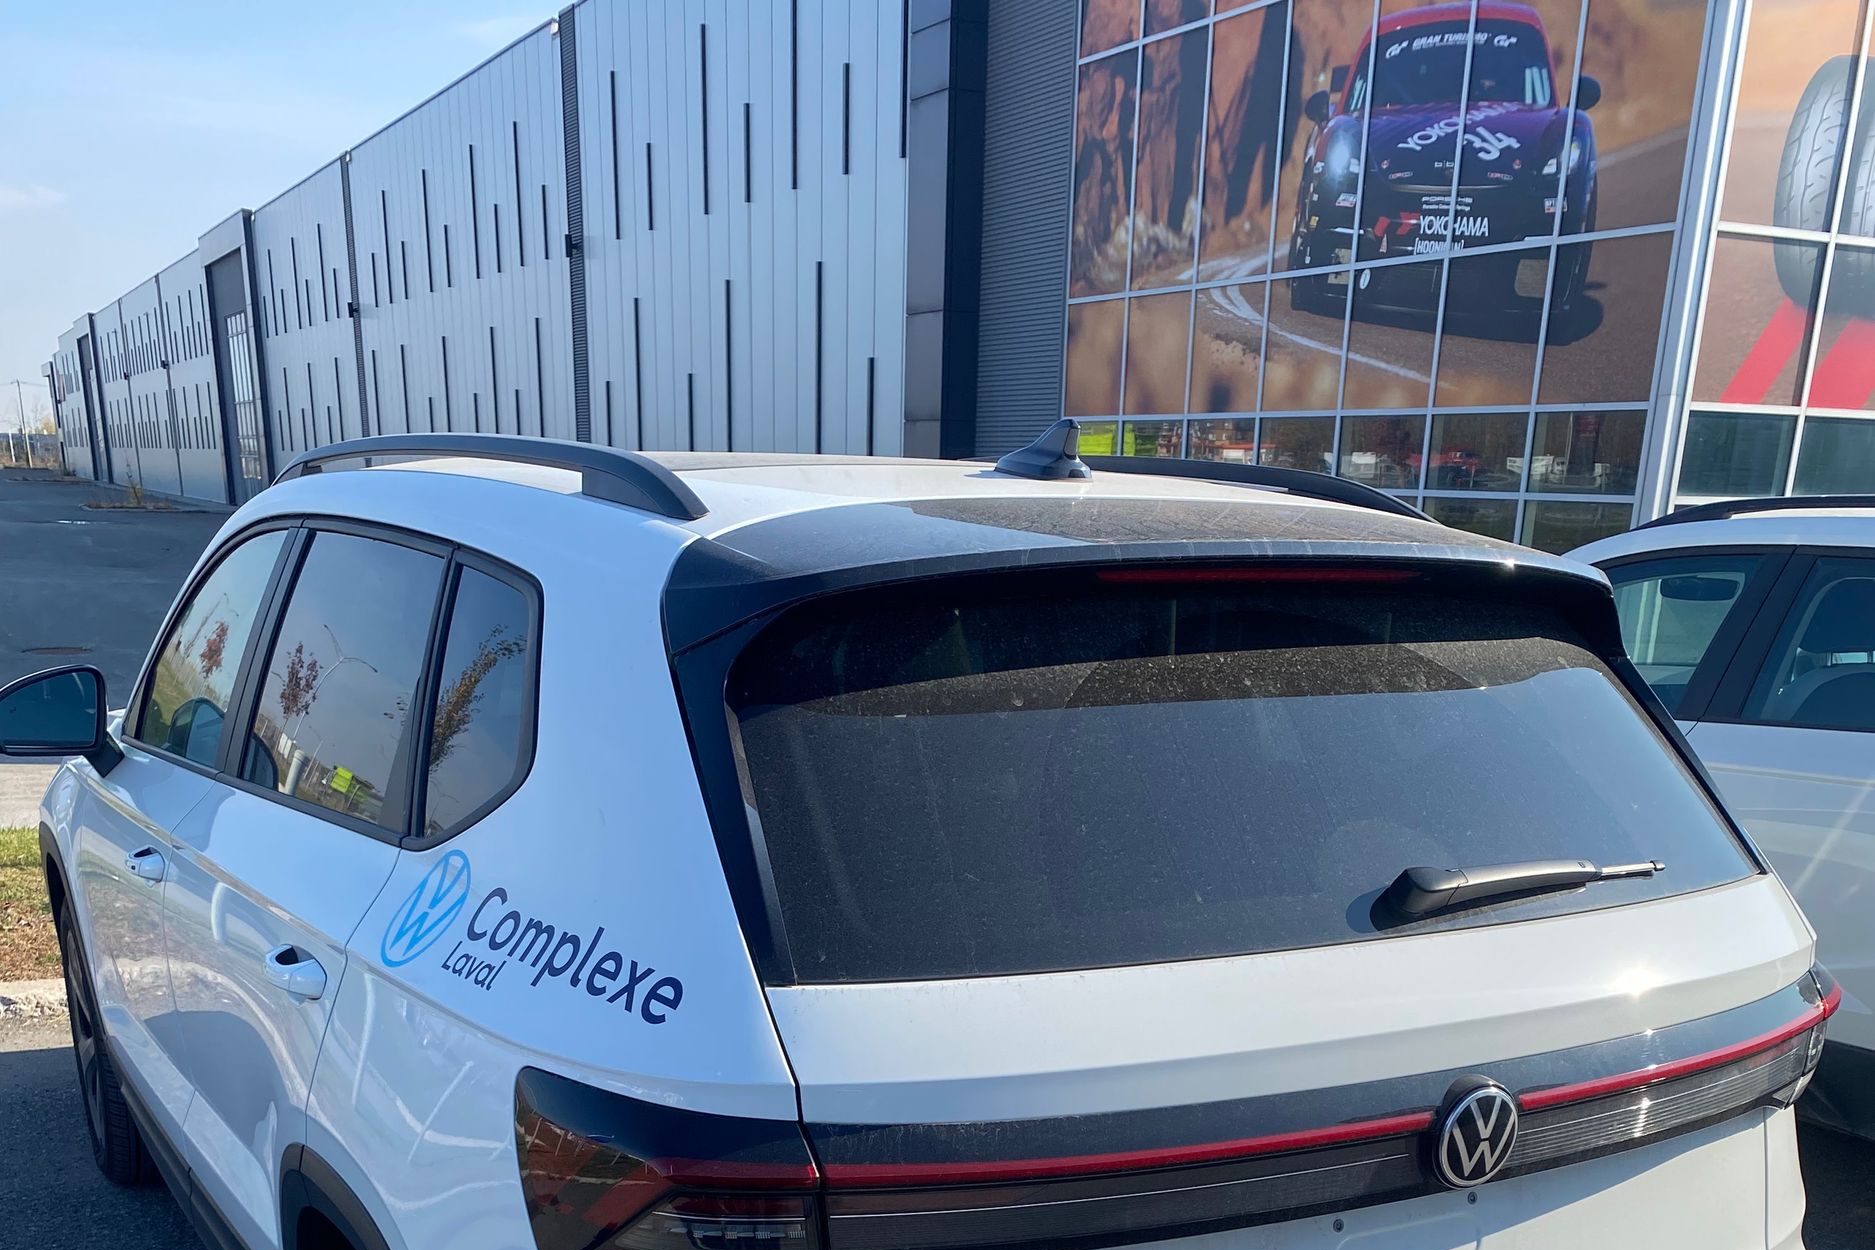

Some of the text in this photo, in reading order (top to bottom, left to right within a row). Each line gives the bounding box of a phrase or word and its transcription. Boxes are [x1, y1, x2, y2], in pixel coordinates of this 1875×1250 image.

[1412, 34, 1442, 47] GRAN
[1443, 31, 1489, 44] TURIMO
[441, 941, 507, 991] Laval
[466, 887, 684, 1025] Complexe
